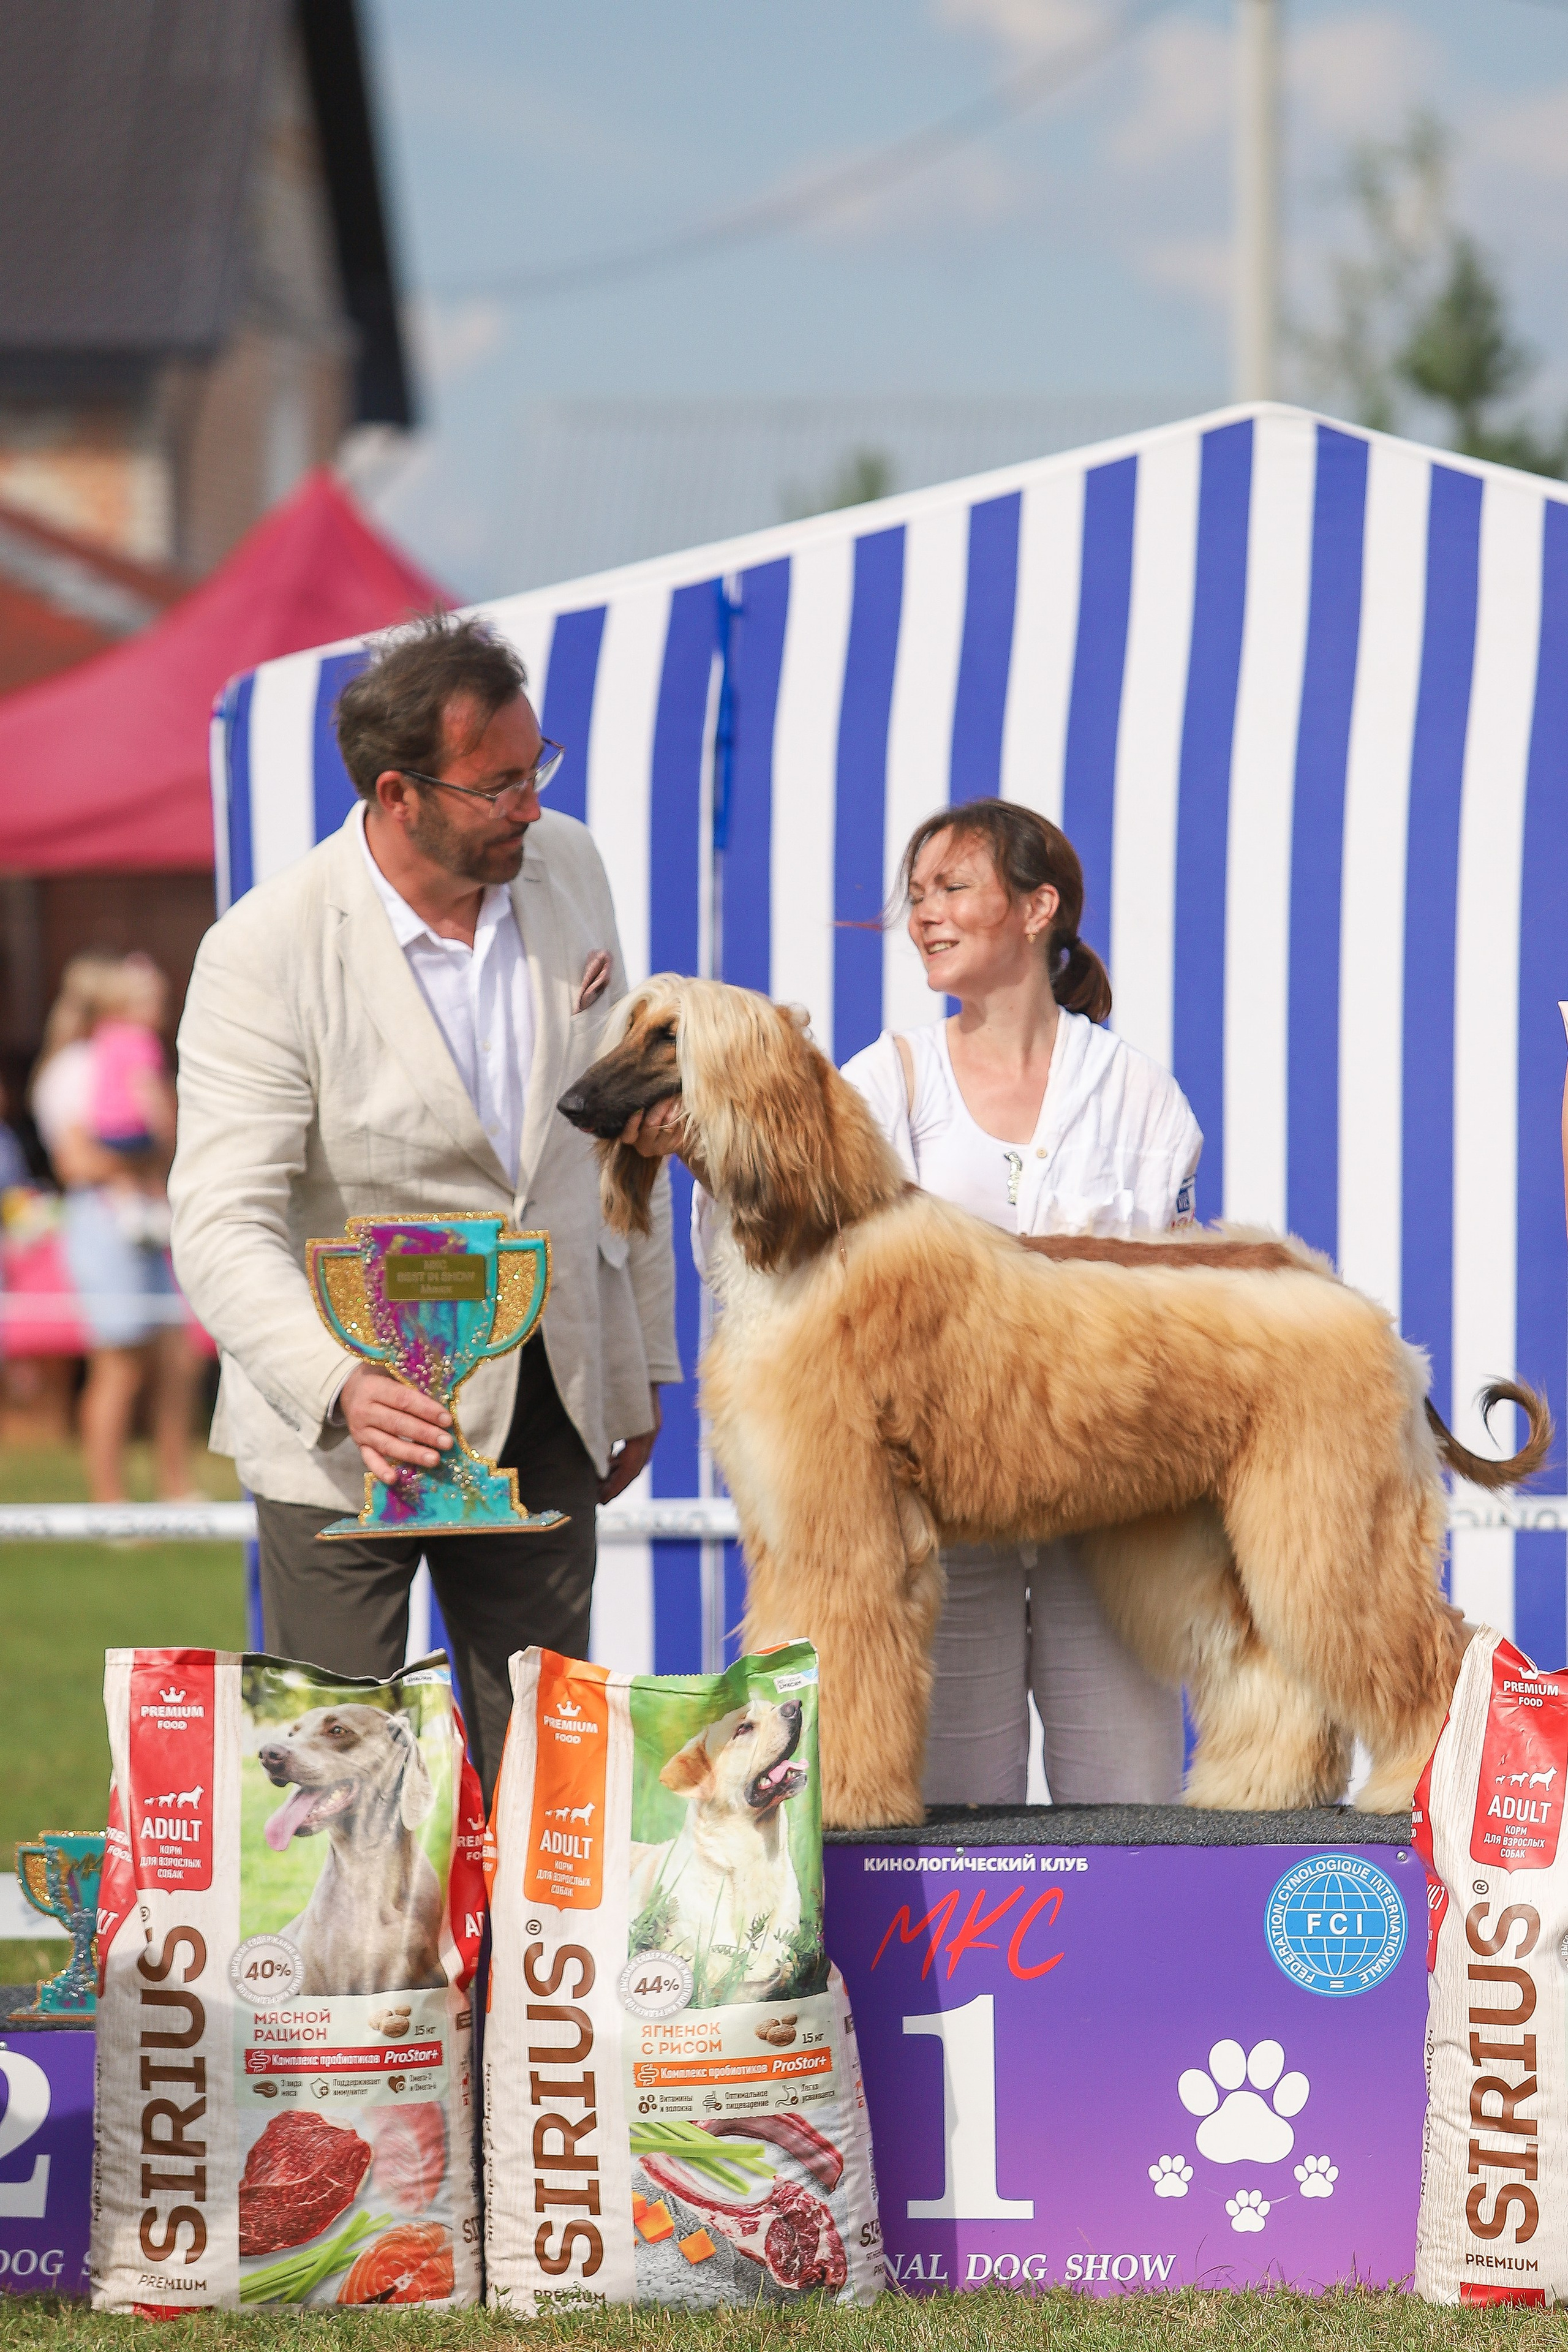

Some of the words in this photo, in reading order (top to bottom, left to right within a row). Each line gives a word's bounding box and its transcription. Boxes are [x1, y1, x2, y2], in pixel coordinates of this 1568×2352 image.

[1504, 1680, 1559, 1697] PREMIUM
[1518, 1695, 1544, 1708] FOOD
[140, 1705, 205, 1718] PREMIUM
[157, 1719, 187, 1730] FOOD
[543, 1714, 598, 1733] PREMIUM
[554, 1732, 582, 1744] FOOD
[1487, 1795, 1552, 1824] ADULT
[140, 1816, 203, 1842] ADULT
[1504, 1824, 1528, 1836] КОРМ
[539, 1828, 594, 1860] ADULT
[1483, 1833, 1501, 1845] ДЛЯ
[1502, 1836, 1545, 1849] ВЗРОСЛЫХ
[159, 1844, 183, 1856] КОРМ
[1500, 1847, 1526, 1860] СОБАК
[140, 1856, 157, 1868] ДЛЯ
[158, 1856, 202, 1869] ВЗРОСЛЫХ
[554, 1860, 575, 1872] КОРМ
[864, 1853, 1037, 1872] КИНОЛОГИЧЕСКИЙ
[1040, 1856, 1090, 1872] КЛУБ
[157, 1868, 184, 1879] СОБАК
[535, 1869, 552, 1880] ДЛЯ
[553, 1872, 592, 1887] ВЗРОСЛЫХ
[1278, 1859, 1371, 1902] CYNOLOGIQUE
[550, 1884, 574, 1898] СОБАК
[1306, 1912, 1363, 1936] FCI
[1357, 1874, 1401, 1985] INTERNATIONALE
[1270, 1903, 1316, 1985] FEDERATION
[244, 1959, 291, 1981] 40%
[633, 1975, 680, 1996] 44%
[254, 2008, 331, 2024] МЯСНОЙ
[254, 2027, 328, 2043] РАЦИОН
[414, 2025, 425, 2036] 15
[641, 2022, 722, 2038] ЯГНЕНОК
[802, 2032, 813, 2044] 15
[641, 2041, 654, 2055] С
[659, 2039, 723, 2055] РИСОМ
[272, 2054, 319, 2066] Комплекс
[383, 2049, 439, 2064] ProStor+
[660, 2067, 708, 2079] Комплекс
[708, 2064, 768, 2079] пробиотиков
[772, 2055, 827, 2073] ProStor+
[1464, 1901, 1542, 2245] SIRIUS
[138, 1924, 208, 2265] SIRIUS
[523, 1940, 604, 2278] SIRIUS
[902, 1994, 1035, 2220] 1
[0, 2049, 51, 2219] 2
[965, 2253, 1049, 2281] DOG
[1064, 2253, 1177, 2281] SHOW
[1465, 2253, 1539, 2272] PREMIUM
[138, 2274, 207, 2291] PREMIUM
